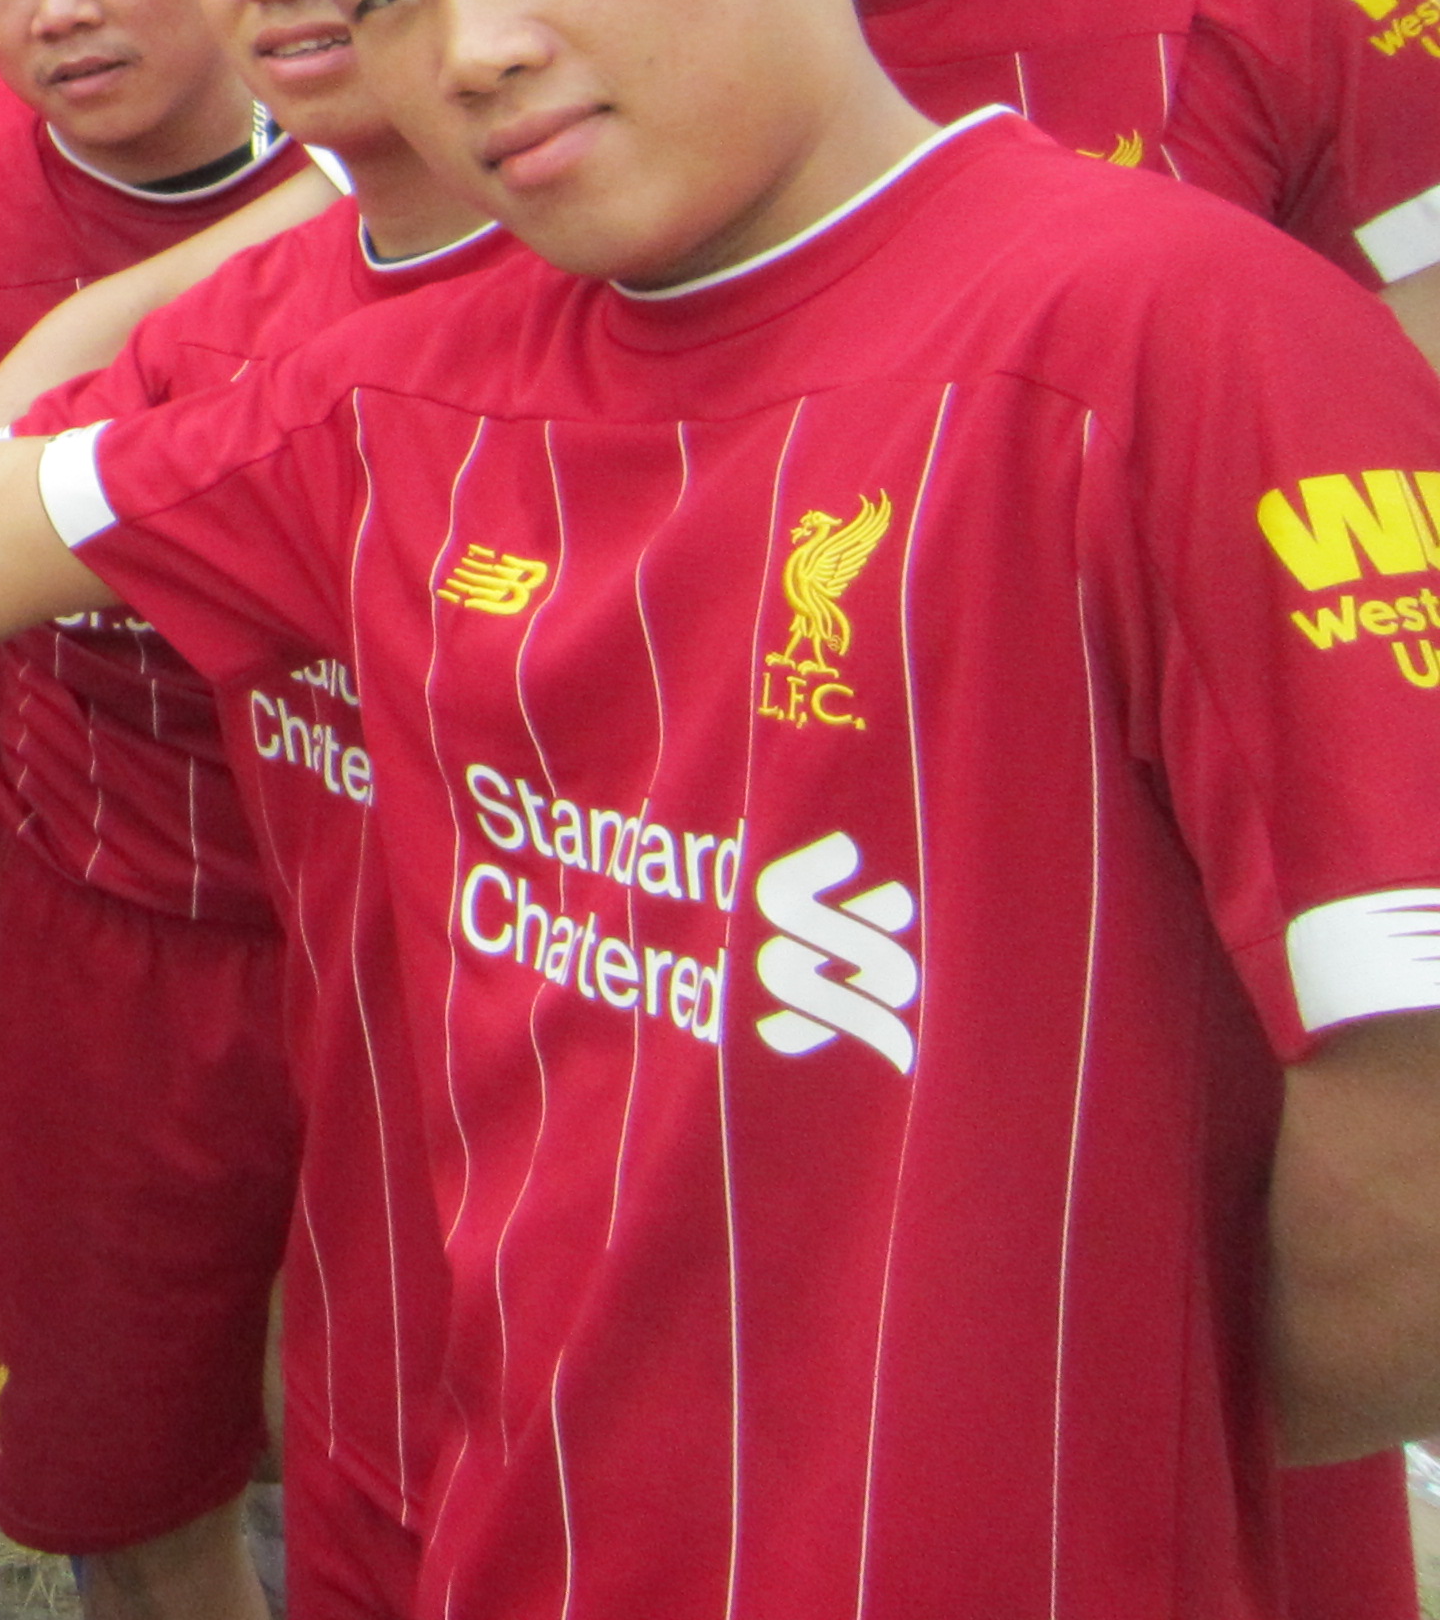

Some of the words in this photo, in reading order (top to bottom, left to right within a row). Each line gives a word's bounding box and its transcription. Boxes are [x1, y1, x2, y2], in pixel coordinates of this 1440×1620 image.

[758, 672, 866, 730] L.F.C.
[465, 763, 747, 913] Standard
[460, 863, 727, 1044] Chartered
